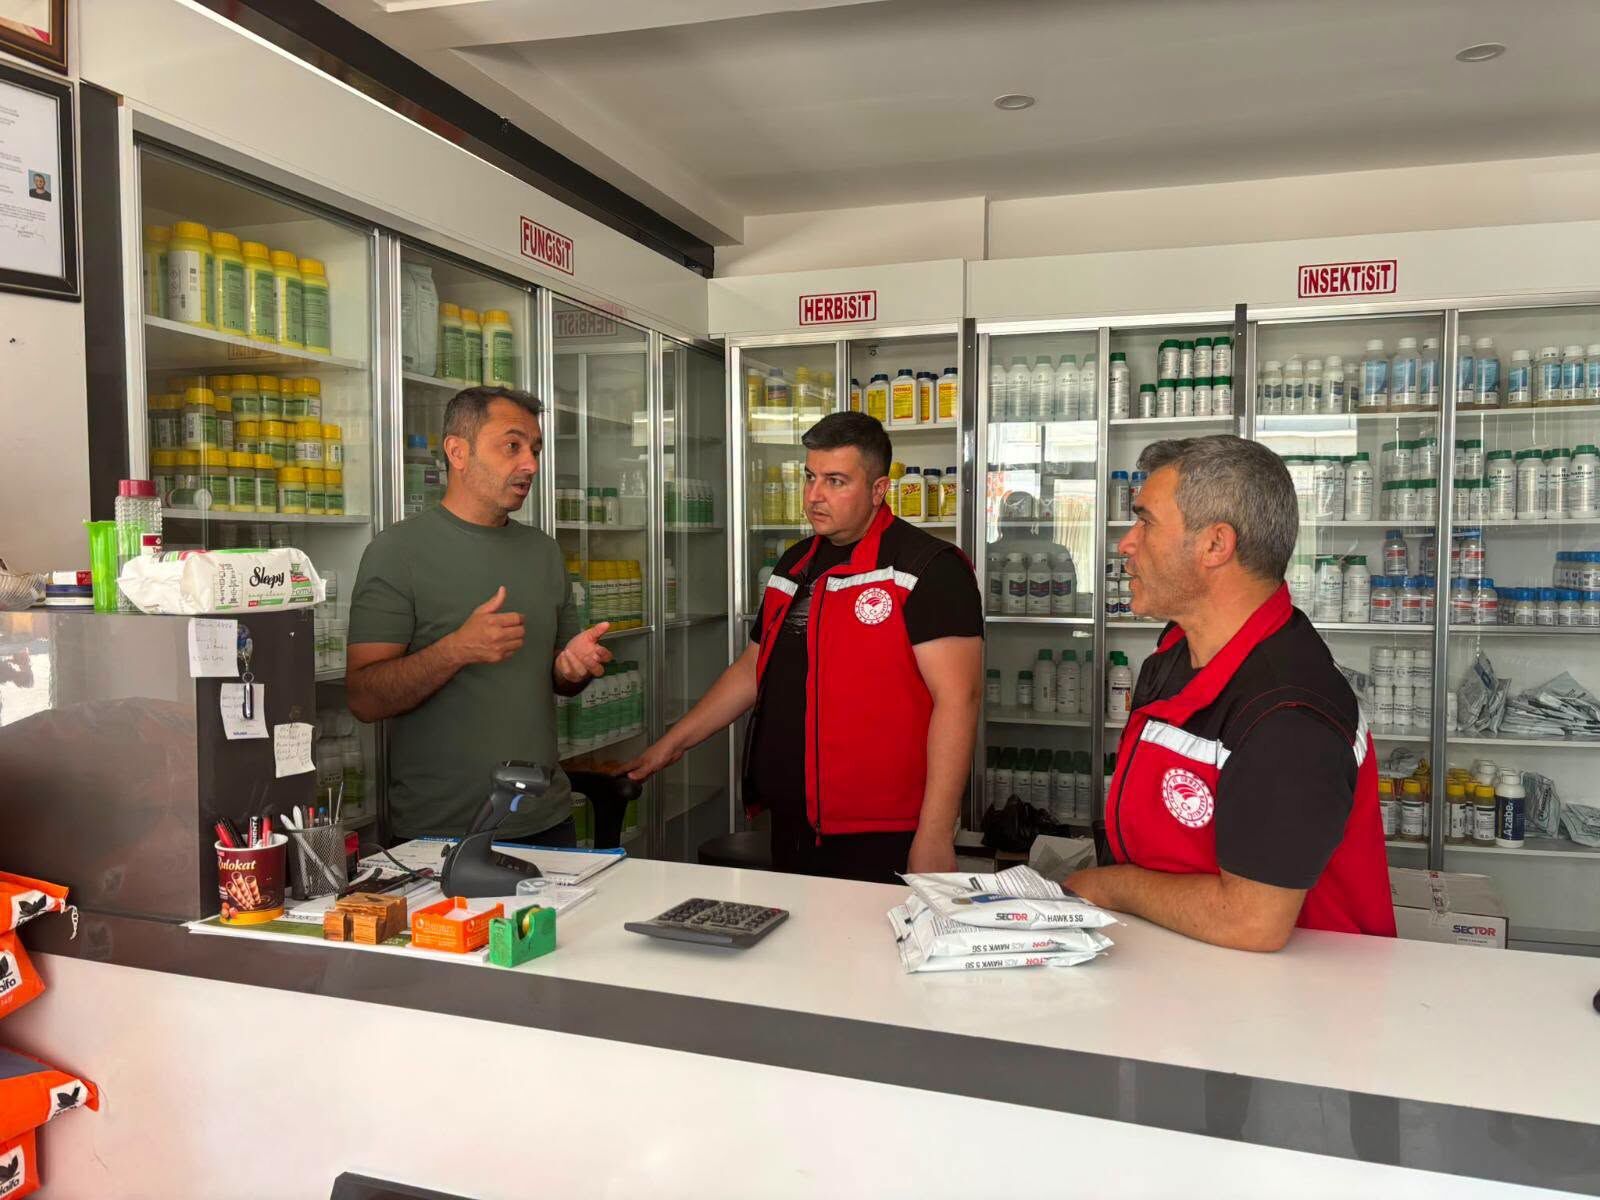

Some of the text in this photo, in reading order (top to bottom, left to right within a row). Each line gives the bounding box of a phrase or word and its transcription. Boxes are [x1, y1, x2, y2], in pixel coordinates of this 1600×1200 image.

[249, 566, 285, 589] Sleepy
[995, 912, 1028, 921] SECTOR
[1047, 914, 1068, 923] HAWK
[1069, 914, 1074, 922] 5
[1452, 924, 1496, 937] SECTOR
[988, 943, 1010, 952] HAWK
[982, 960, 1003, 969] HAWK
